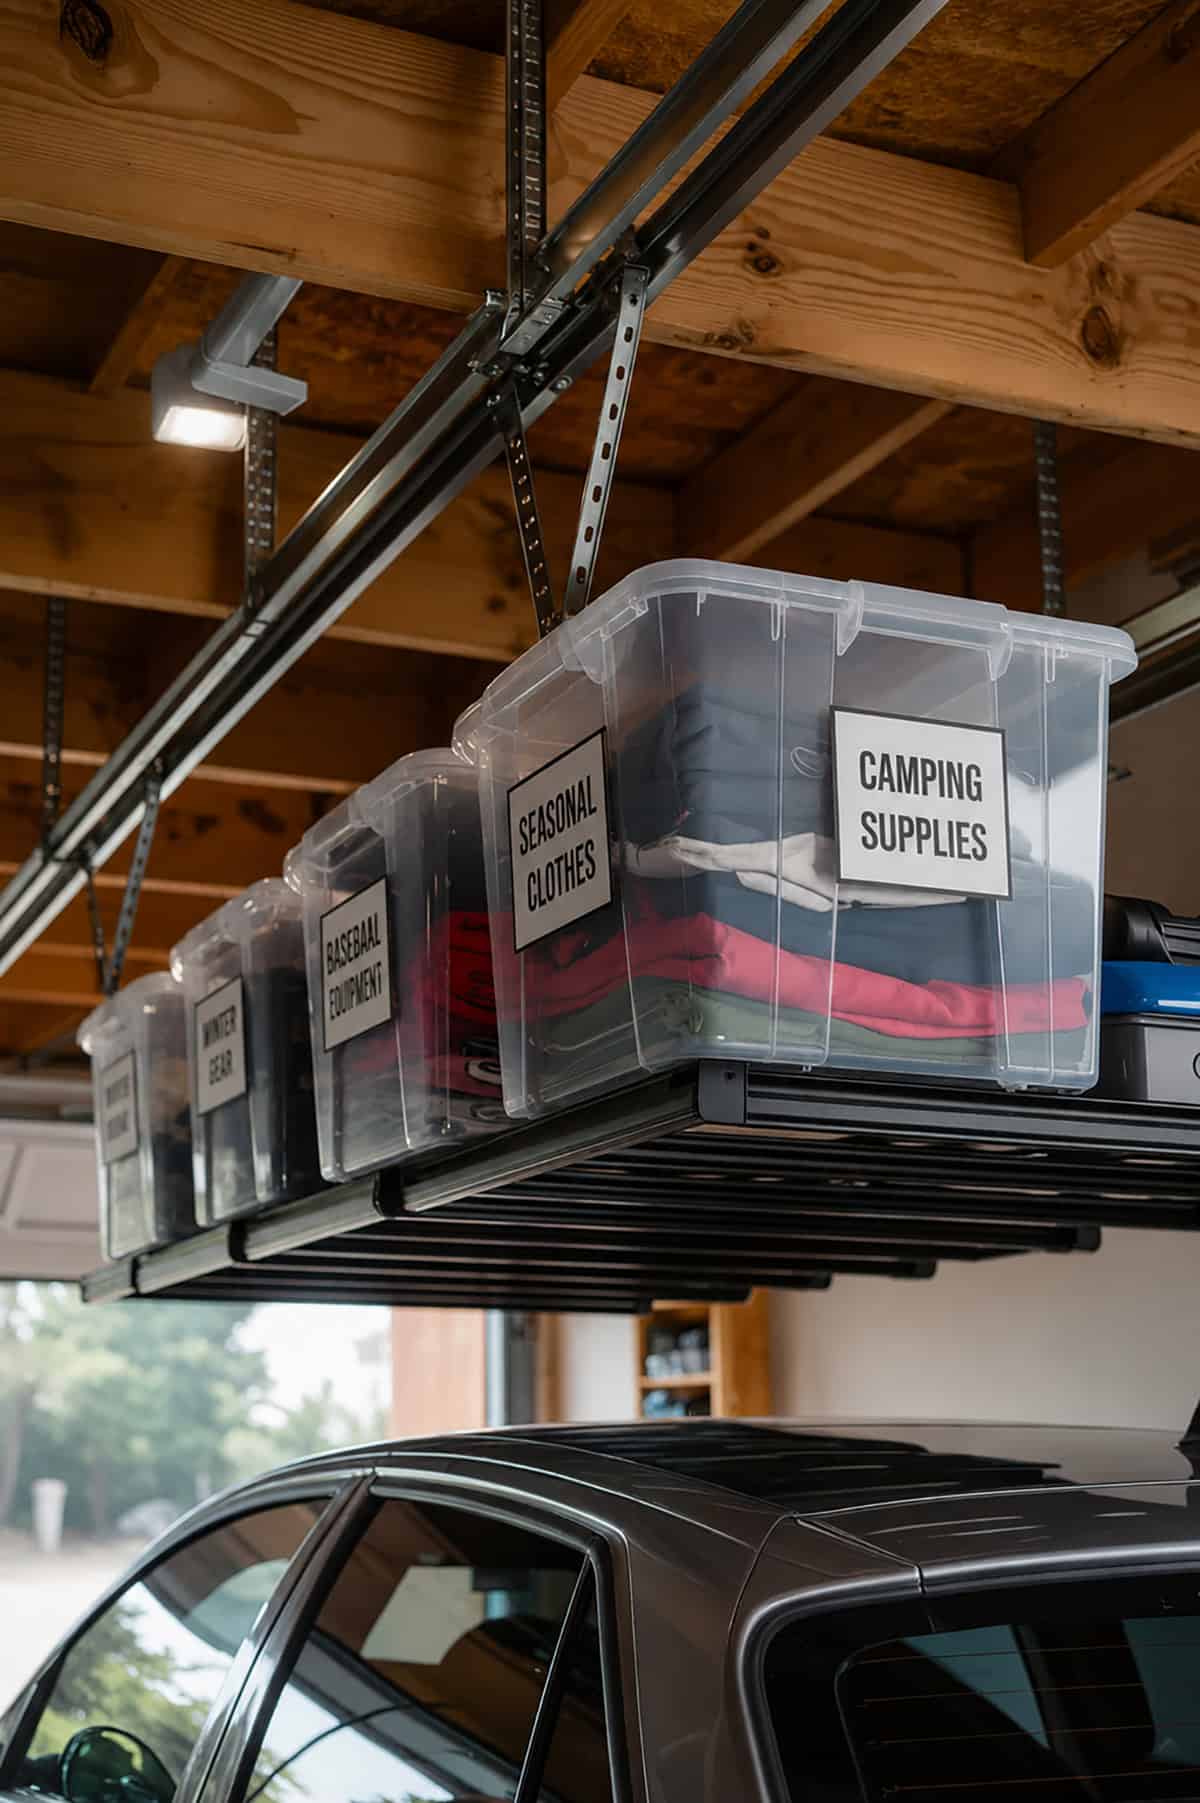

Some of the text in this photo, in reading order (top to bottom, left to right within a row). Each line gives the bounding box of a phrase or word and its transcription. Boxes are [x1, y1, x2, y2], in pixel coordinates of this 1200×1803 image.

[859, 750, 983, 802] CAMPING
[519, 775, 597, 856] SEASONAL
[861, 811, 988, 861] SUPPLIES
[527, 839, 596, 912] CLOTHES
[329, 961, 382, 1021] EQUIPMENT
